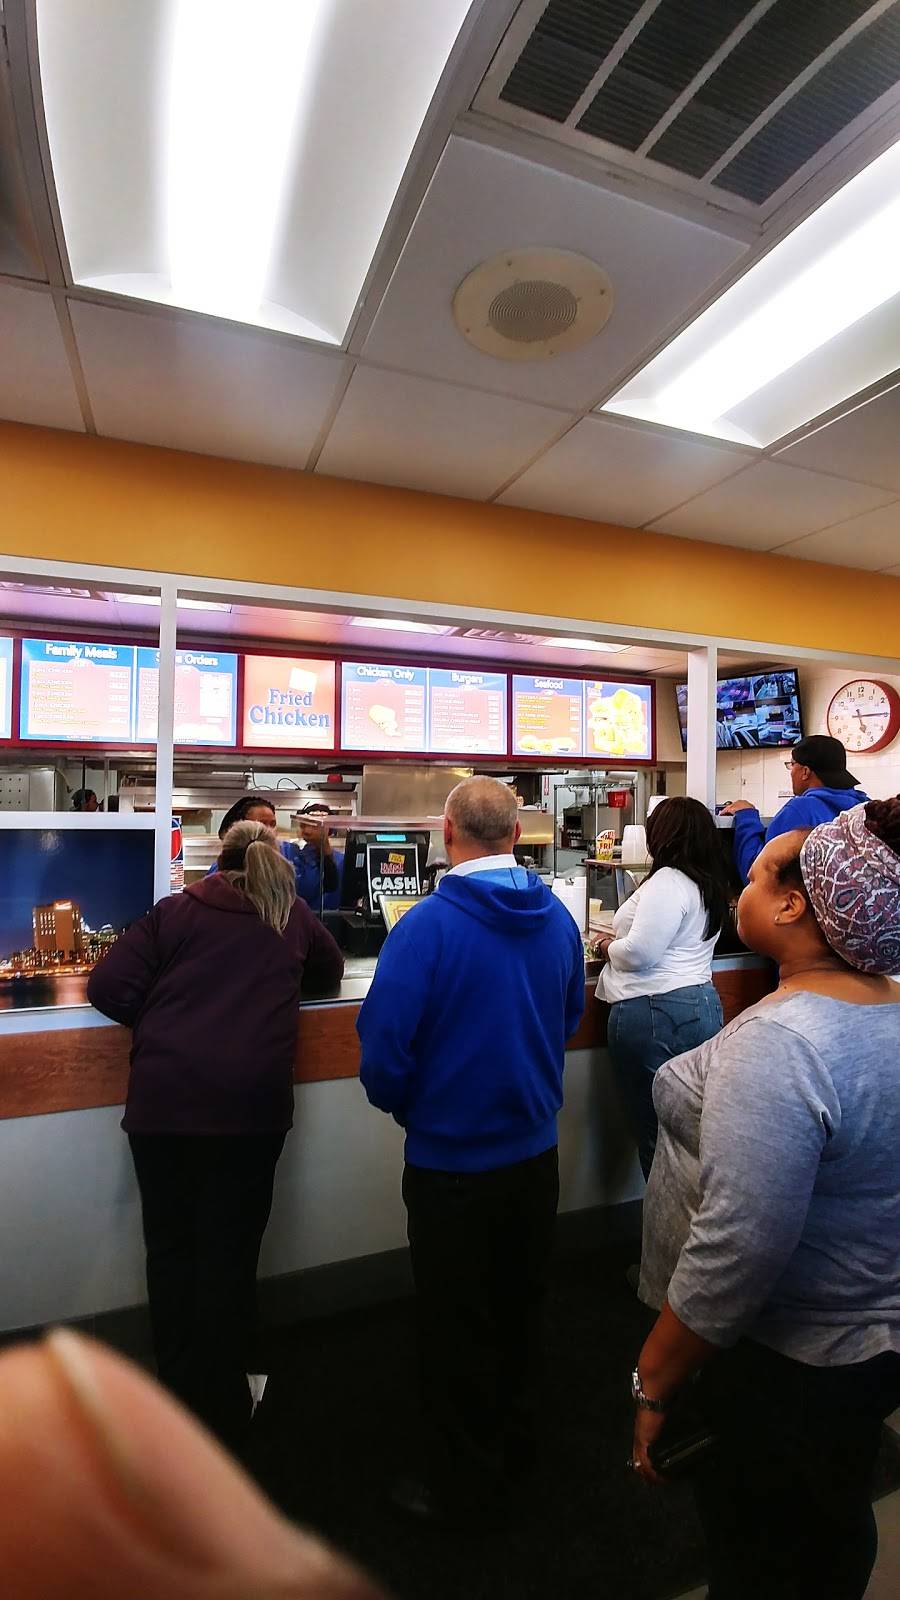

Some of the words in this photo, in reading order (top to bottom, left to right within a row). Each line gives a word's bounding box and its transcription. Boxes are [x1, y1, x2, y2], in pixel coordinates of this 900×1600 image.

[45, 643, 83, 659] Family
[84, 645, 118, 660] Meals
[185, 653, 219, 666] Orders
[356, 665, 393, 678] Chicken
[393, 669, 415, 682] Only
[451, 672, 484, 685] Burgers
[534, 679, 564, 690] Seafood
[269, 688, 313, 706] Fried
[249, 705, 330, 728] Chicken
[371, 876, 417, 891] CASH
